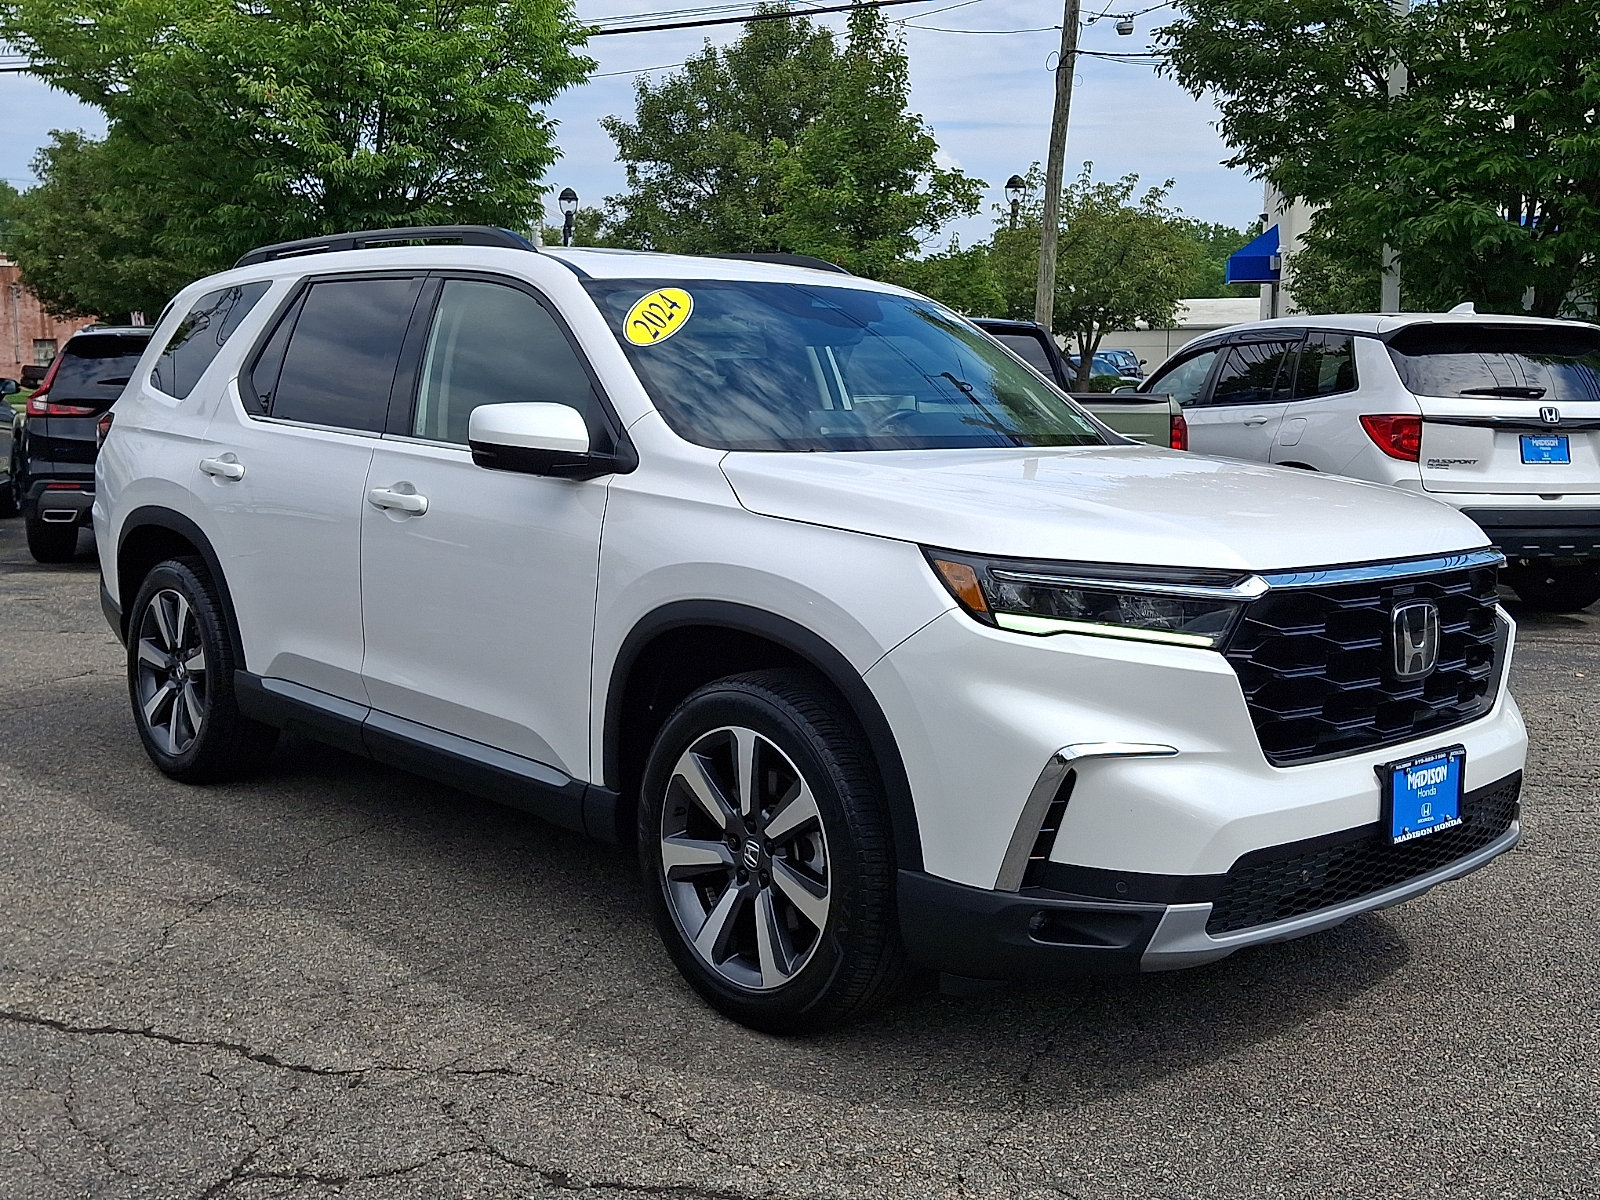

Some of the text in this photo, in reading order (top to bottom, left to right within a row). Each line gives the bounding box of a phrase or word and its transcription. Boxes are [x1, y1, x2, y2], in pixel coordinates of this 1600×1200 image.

[633, 293, 681, 339] 2024
[1407, 765, 1447, 790] MADISON
[1417, 787, 1436, 798] Honda
[1394, 817, 1463, 844] MADISON HONDA
